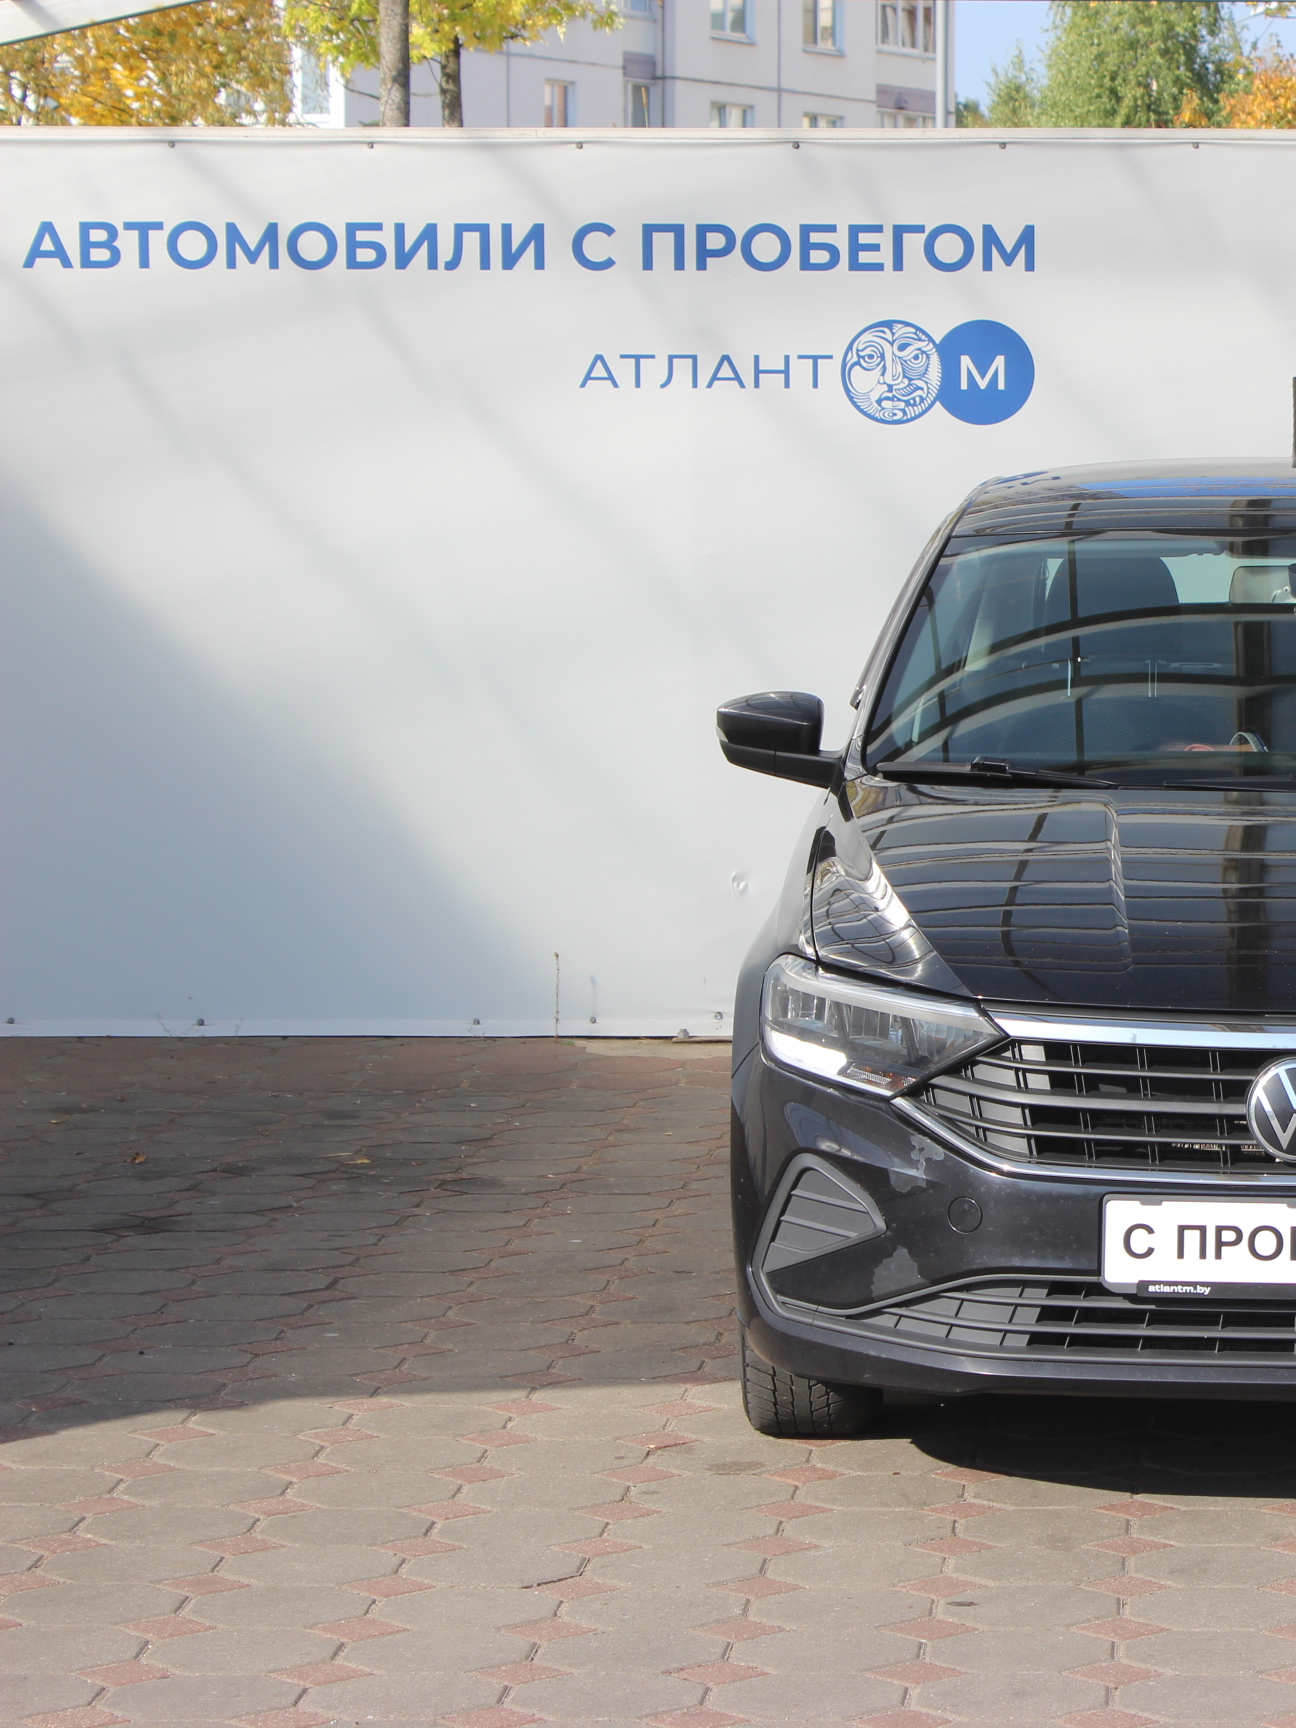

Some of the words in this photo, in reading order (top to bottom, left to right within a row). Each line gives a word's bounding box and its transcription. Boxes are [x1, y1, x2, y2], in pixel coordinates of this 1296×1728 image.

[23, 220, 546, 271] АВТОМОБИЛИ
[572, 221, 617, 271] С
[641, 222, 1036, 272] ПРОБЕГОМ
[579, 353, 834, 389] АТЛАНТ
[960, 355, 1006, 391] М
[1122, 1223, 1156, 1260] С
[1147, 1284, 1211, 1296] atlantm.by
